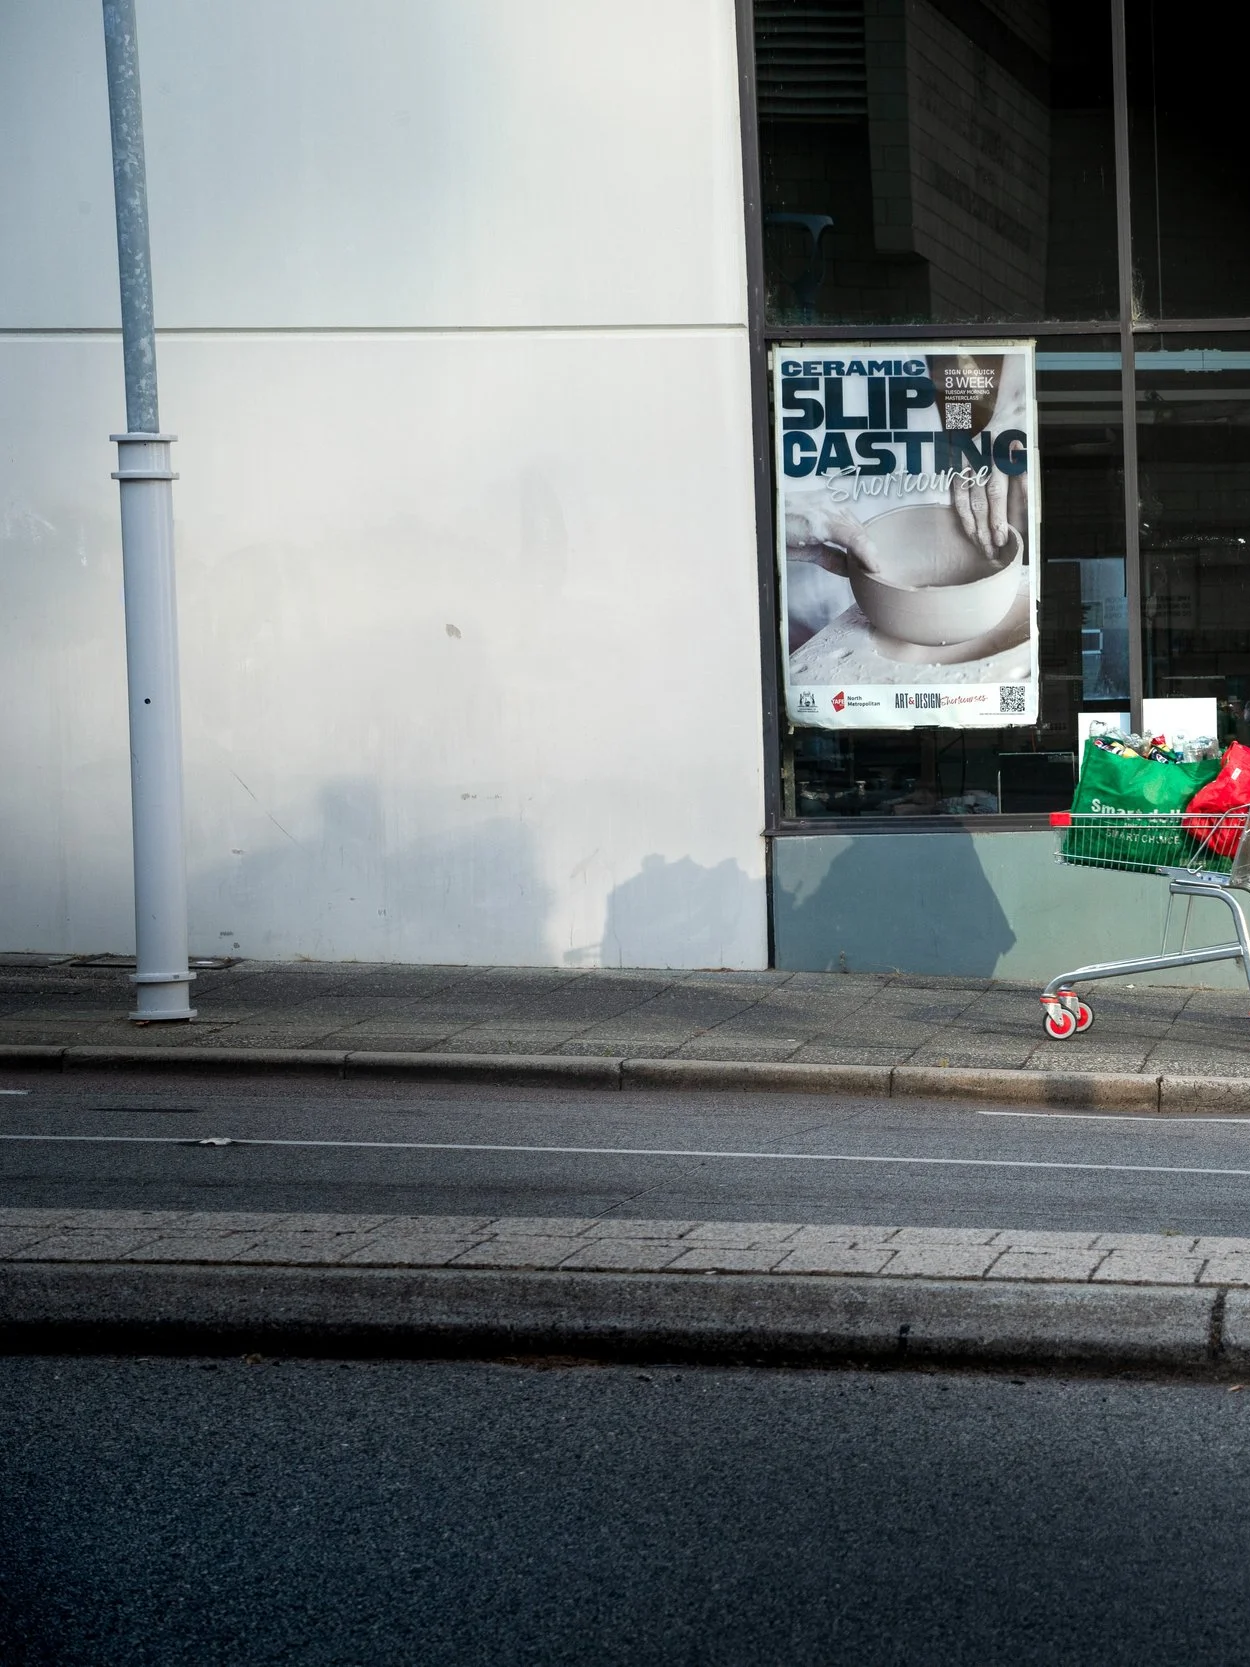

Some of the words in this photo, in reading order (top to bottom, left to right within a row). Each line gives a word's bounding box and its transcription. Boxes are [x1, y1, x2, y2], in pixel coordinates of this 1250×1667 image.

[781, 360, 926, 377] CERAMIC
[945, 376, 954, 388] 8
[956, 376, 994, 388] WEEK
[973, 368, 995, 376] QUICK
[782, 376, 937, 430] SLIP
[782, 429, 1028, 478] CASTING
[821, 464, 992, 502] Shortcourse
